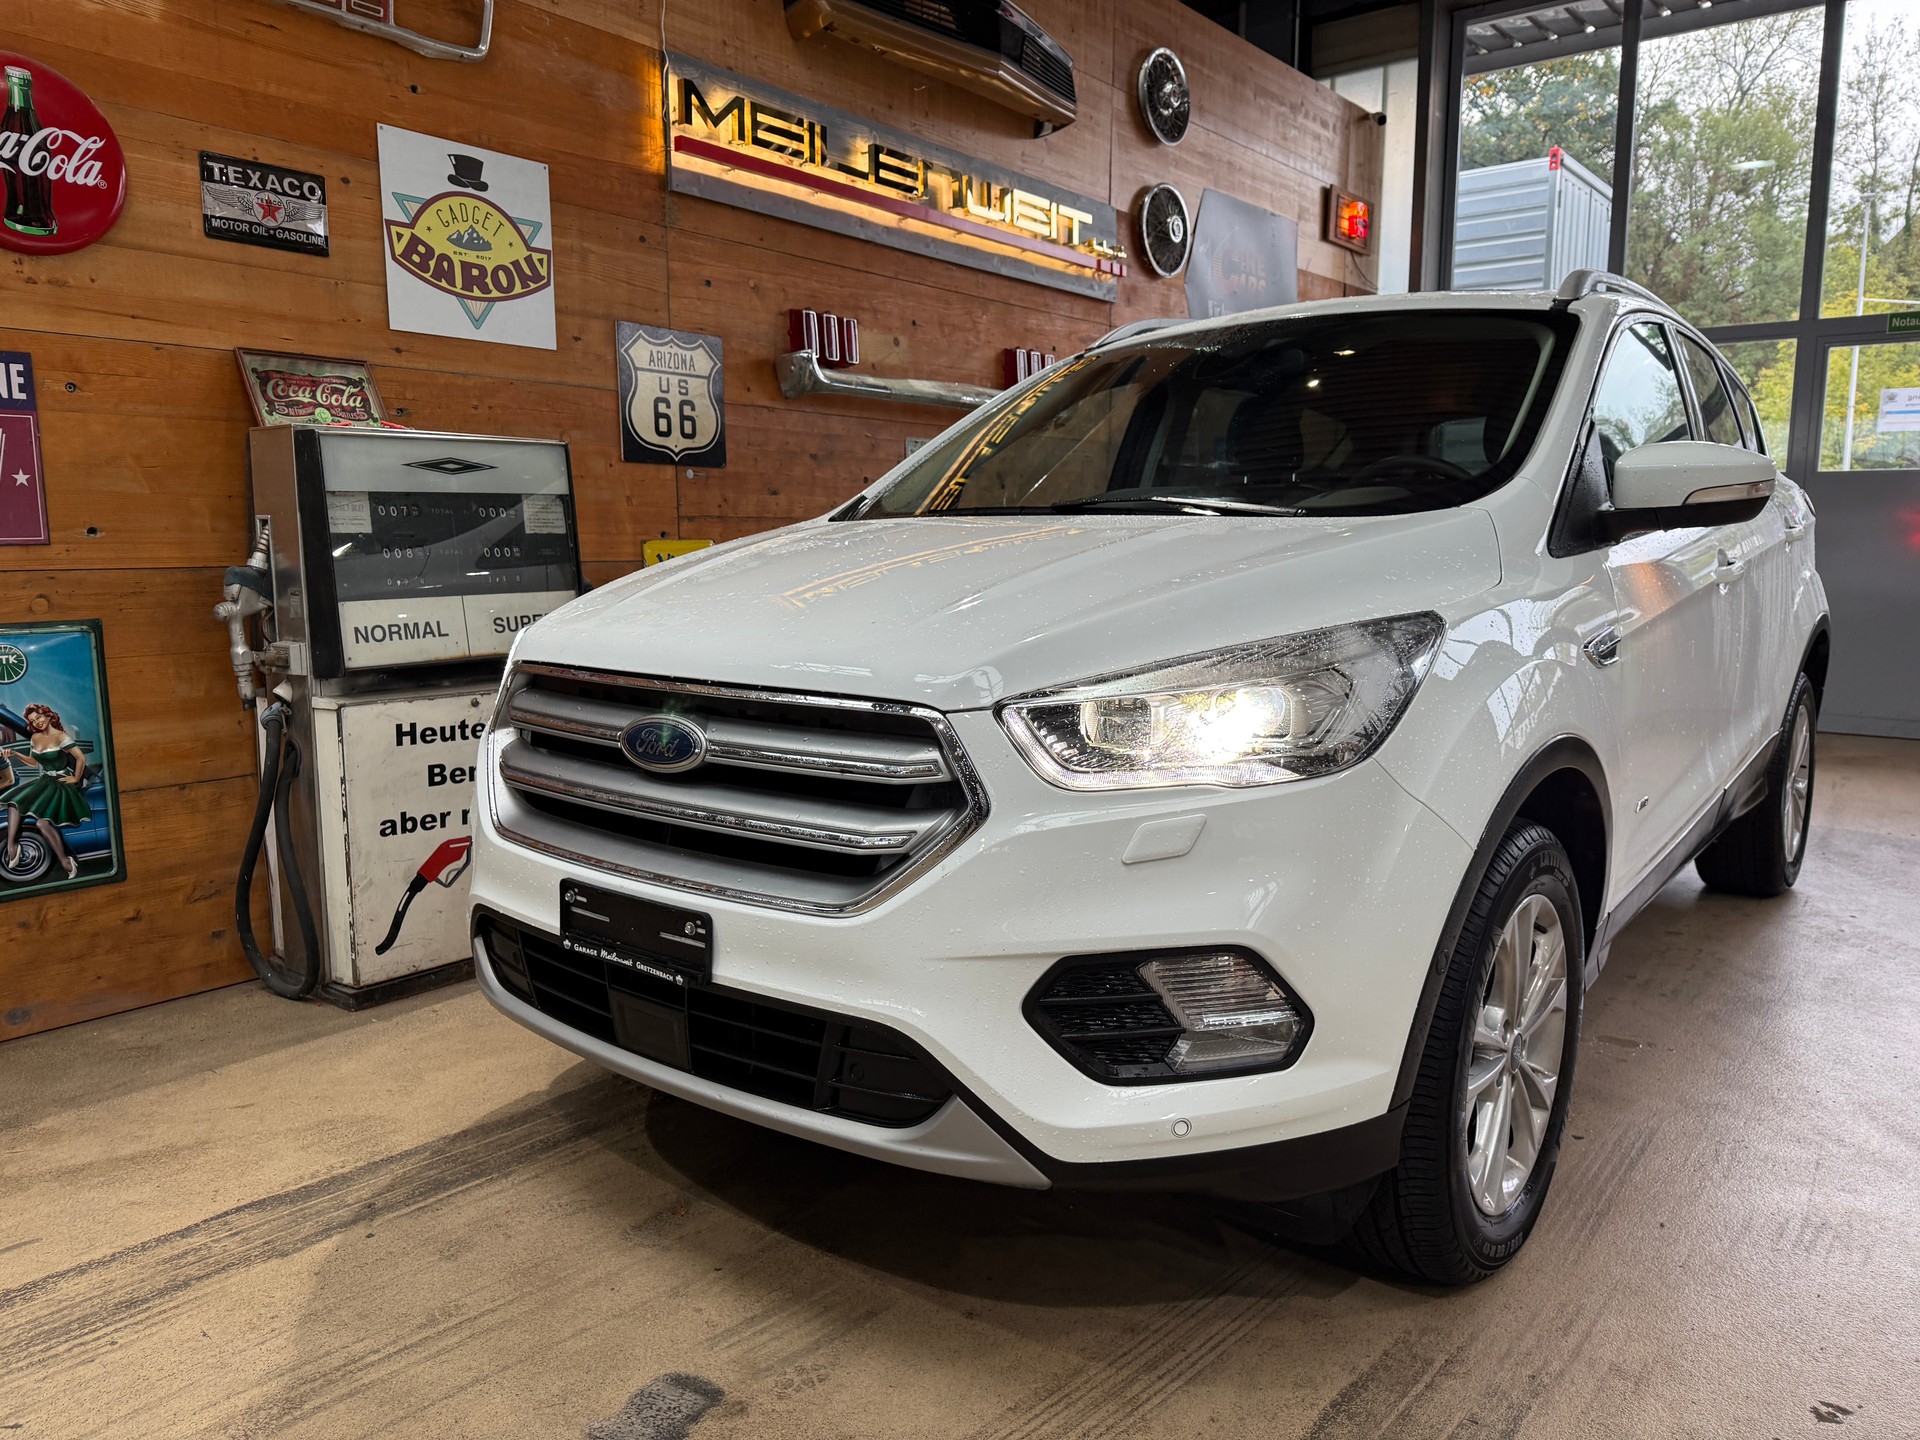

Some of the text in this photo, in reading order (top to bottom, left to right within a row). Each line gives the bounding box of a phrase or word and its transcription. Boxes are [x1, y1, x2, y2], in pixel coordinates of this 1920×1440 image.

[207, 161, 322, 200] TEXACO
[211, 218, 325, 246] MOTOR OIL GASOLINE
[436, 202, 504, 237] GADGET
[398, 231, 546, 295] BARON
[475, 253, 492, 261] 2017
[648, 349, 696, 372] ARIZONA
[266, 378, 364, 408] Coca-Cola
[653, 396, 697, 440] 66
[354, 621, 449, 645] NORMAL
[395, 718, 486, 747] Heute
[636, 727, 680, 757] Ford
[379, 811, 452, 838] aber
[573, 943, 598, 957] GARAGE
[635, 961, 674, 983] GRETZENBACH
